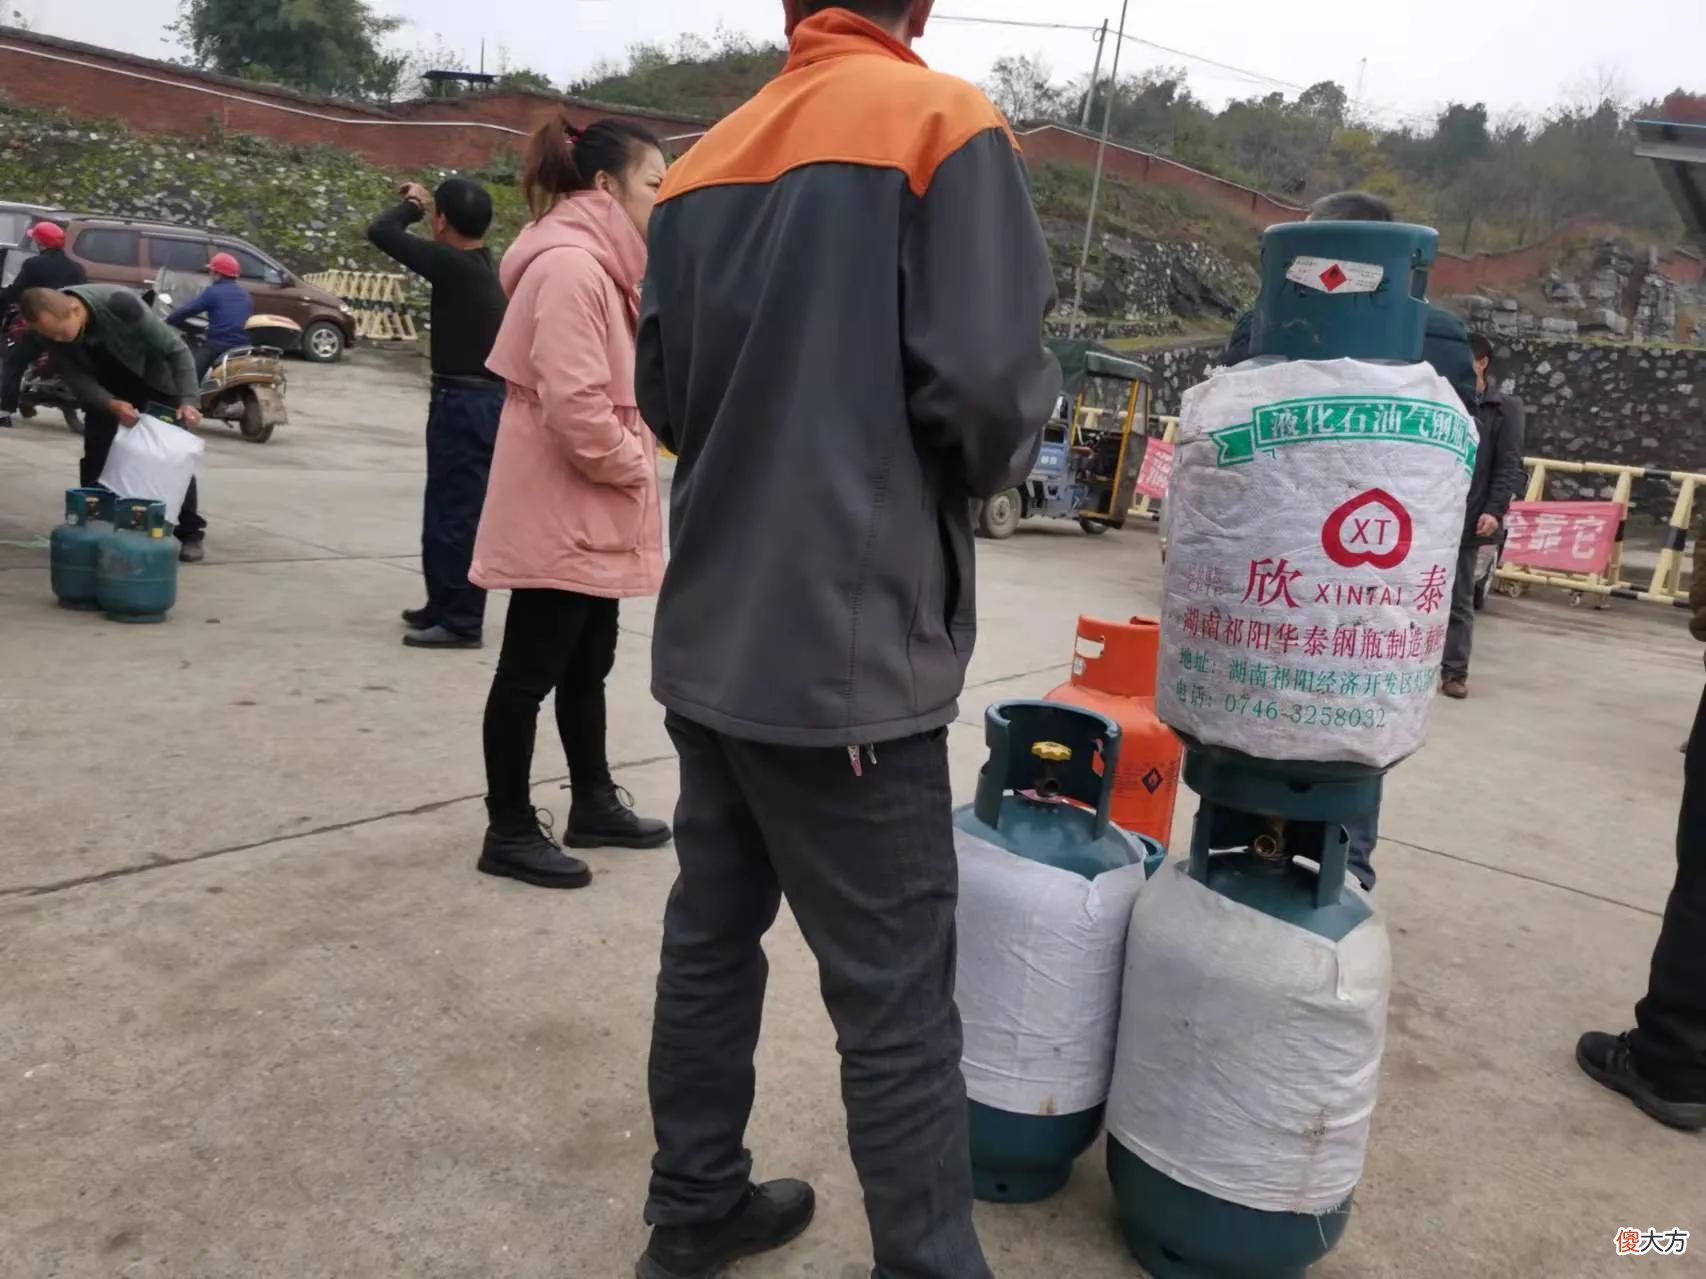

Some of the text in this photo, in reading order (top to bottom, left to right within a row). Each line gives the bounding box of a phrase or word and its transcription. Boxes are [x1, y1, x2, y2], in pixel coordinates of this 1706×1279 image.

[1349, 518, 1392, 545] XT
[1240, 557, 1303, 609] 欣
[1314, 582, 1402, 607] XINTAI
[1414, 564, 1447, 614] 泰
